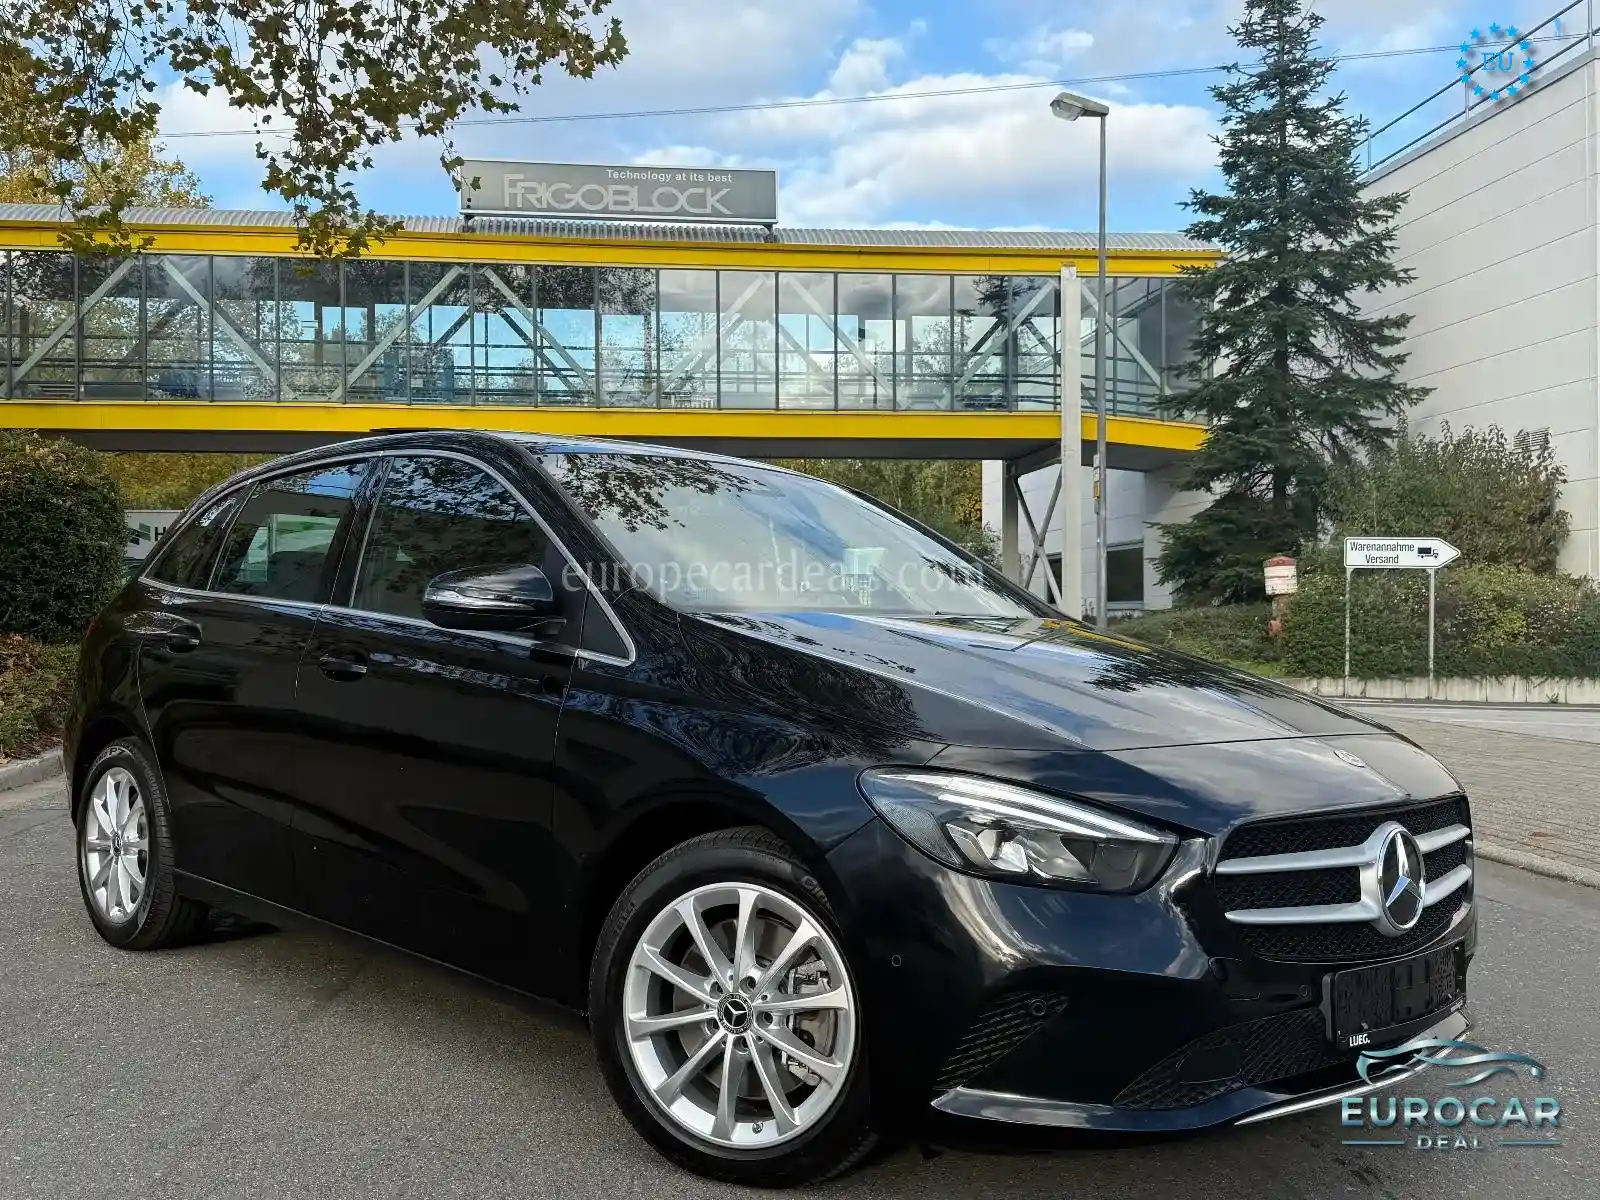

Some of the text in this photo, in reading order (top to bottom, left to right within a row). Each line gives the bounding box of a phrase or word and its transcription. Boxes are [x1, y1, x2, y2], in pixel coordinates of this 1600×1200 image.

[607, 169, 732, 182] Technology at its best
[503, 173, 733, 215] FRIGOBLOCK
[1350, 541, 1415, 552] Warenannahme
[1365, 554, 1399, 564] Versand
